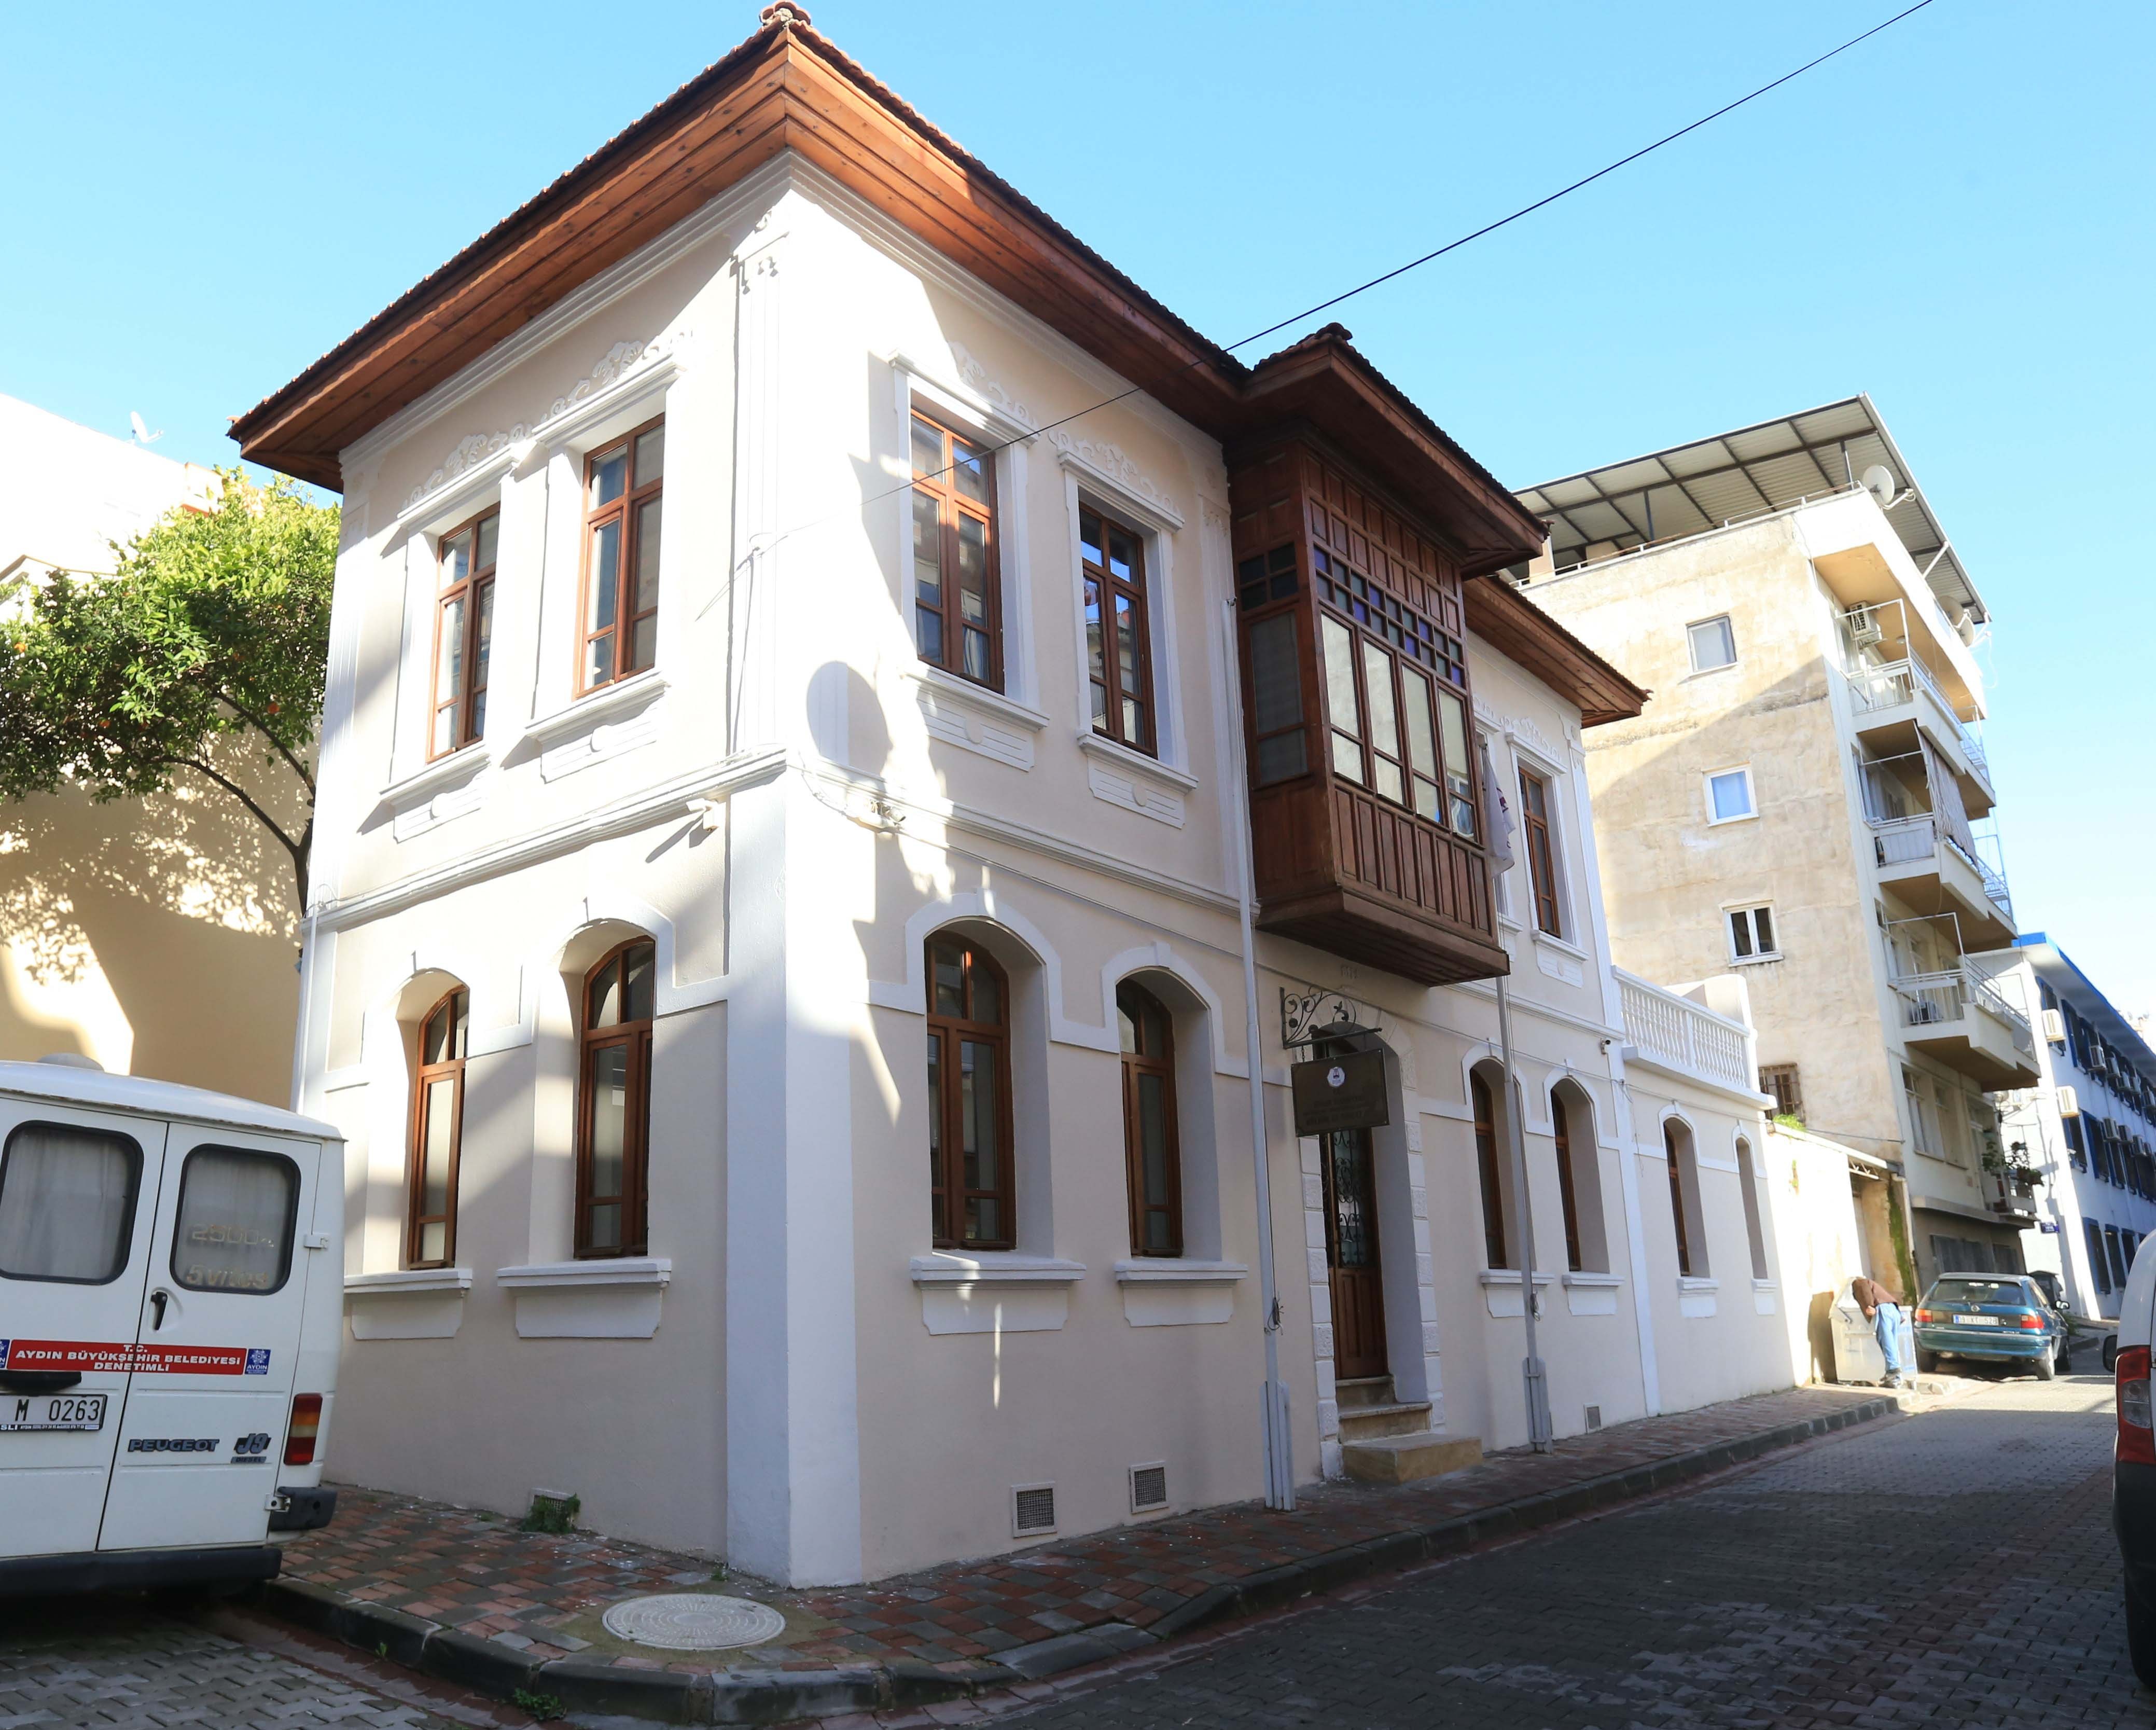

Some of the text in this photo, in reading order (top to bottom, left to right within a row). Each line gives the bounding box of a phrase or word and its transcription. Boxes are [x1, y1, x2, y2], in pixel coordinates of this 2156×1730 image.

[16, 1350, 62, 1360] AYDIN
[67, 1351, 160, 1363] BÜYÜKŞEHİR
[164, 1355, 240, 1365] BELEDİYESİ
[94, 1362, 170, 1372] DENETİMLİ
[15, 1399, 100, 1421] M 0263
[128, 1433, 269, 1455] PEUGEOT J9
